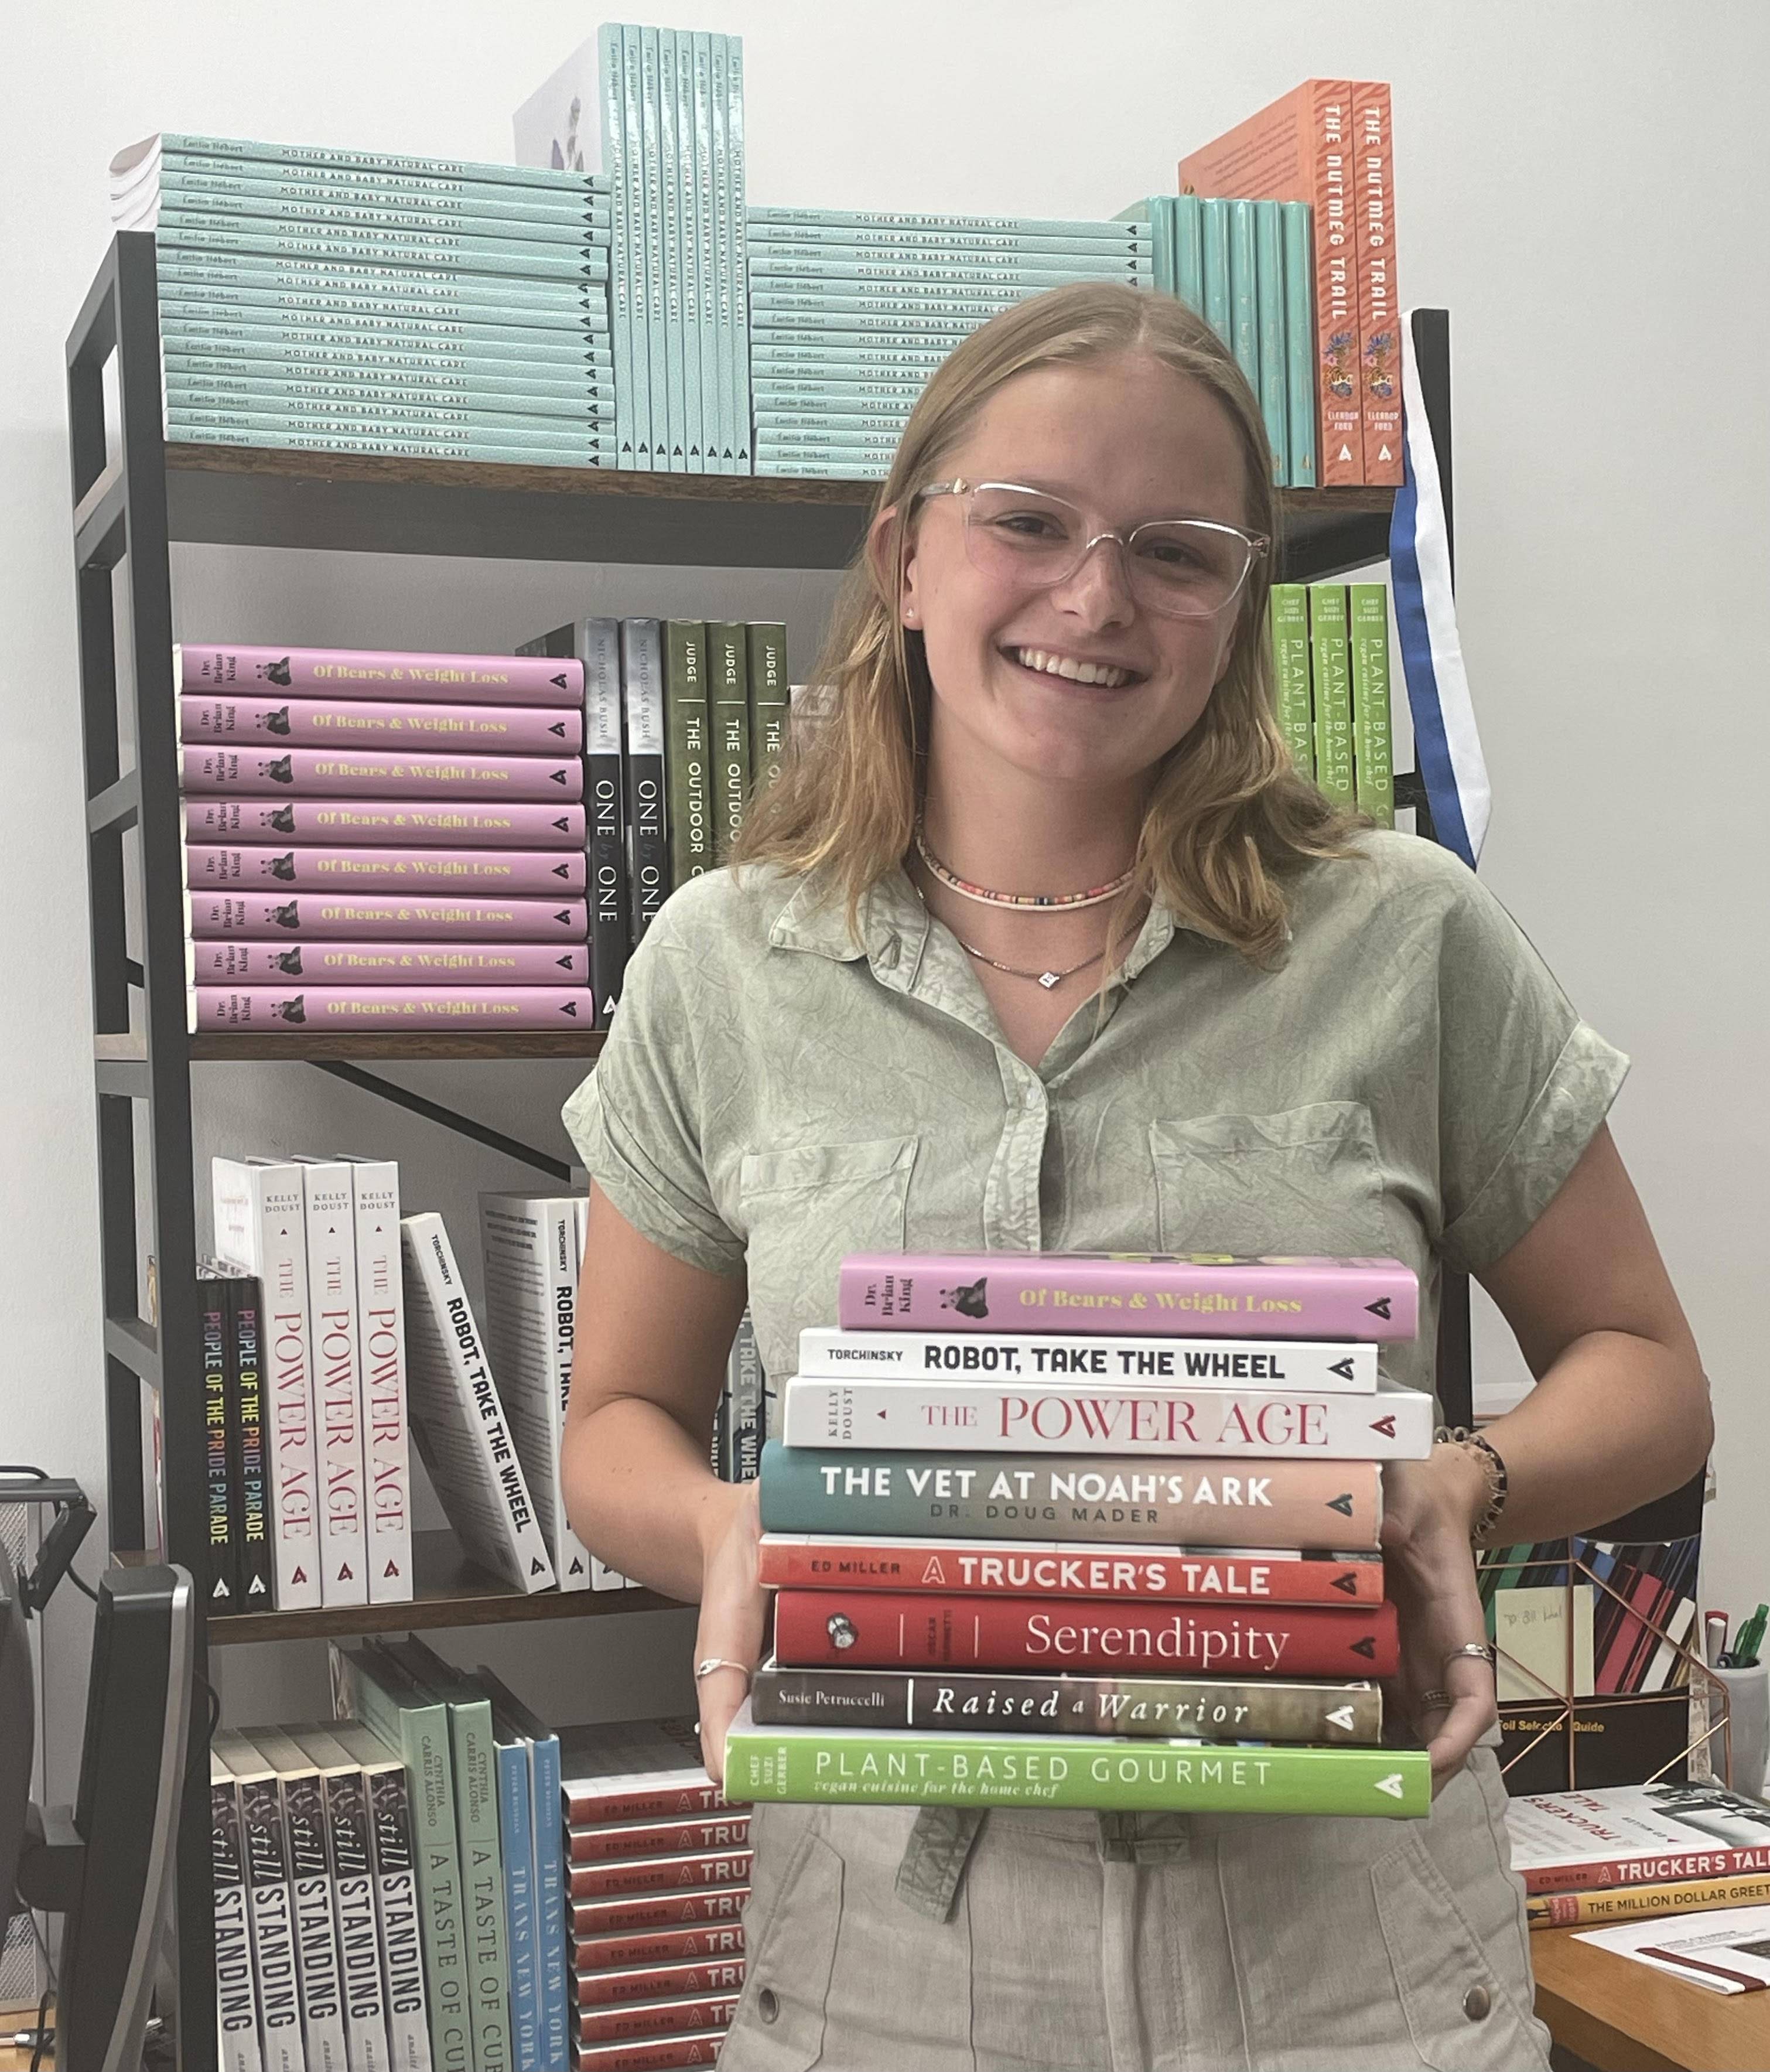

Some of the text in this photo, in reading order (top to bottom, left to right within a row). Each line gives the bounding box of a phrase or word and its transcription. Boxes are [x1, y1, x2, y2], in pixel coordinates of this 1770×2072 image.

[329, 210, 351, 218] AND
[1324, 104, 1348, 319] THE NUTMEG TRAIL
[1364, 107, 1388, 319] THE NUTMEG TRAIL
[214, 654, 223, 684] Brian
[227, 656, 237, 681] King
[313, 664, 509, 684] Of Bears & Weight Loss
[686, 641, 696, 684] JUDGE
[725, 643, 736, 685] JUDGE
[597, 639, 608, 738] NICHOLAS BUSH
[686, 718, 701, 751] THE
[726, 719, 741, 752] THE
[1331, 639, 1349, 791] PLANT-BASED
[596, 780, 615, 837] ONE
[688, 762, 703, 854] OUTDOOR
[598, 865, 617, 922] ONE
[265, 1203, 300, 1214] DOUST
[266, 1194, 299, 1203] KELLY
[360, 1200, 395, 1210] DOUST
[361, 1192, 394, 1200] KELLY
[558, 1220, 568, 1271] TORCHINSKY
[865, 1284, 877, 1308] Dr.
[881, 1275, 895, 1317] Brian
[898, 1278, 913, 1314] King
[1019, 1288, 1303, 1316] Of Bears & Weight Loss
[556, 1286, 574, 1353] ROBOT,
[739, 1333, 756, 1386] TAKE
[827, 1346, 1285, 1380] TORCHINSKY ROBOT, TAKE THE WHEEL
[274, 1258, 312, 1541] THE POWER AGE
[368, 1255, 404, 1534] THE POWER AGE
[430, 1234, 532, 1534] TORCHINSKY ROBOT, TAKE THE WHEEL
[238, 1309, 264, 1542] PEOPLE OF THE PRIDE PARADE
[740, 1391, 757, 1430] THE
[828, 1388, 838, 1438] KELLY
[843, 1387, 853, 1440] DOUST
[920, 1397, 1330, 1446] THE POWER AGE
[821, 1466, 1273, 1507] THE VET AT NOAH'S ARK
[930, 1503, 1159, 1523] DR. DOUG MADER
[811, 1557, 1271, 1595] ED MILLER A TRUCKER'S TALE
[1025, 1614, 1290, 1671] Serendipity
[778, 1688, 885, 1708] Susie Petruccelli
[932, 1688, 1250, 1722] Raised a Warrior
[1573, 1722, 1604, 1732] Guide
[466, 1733, 480, 1822] CARRIS ALONSO
[478, 1752, 488, 1803] CYNTHIA
[750, 1755, 760, 1786] CHEF
[763, 1757, 774, 1784] SUZI
[777, 1746, 787, 1795] GERBER
[814, 1780, 1060, 1798] vegan cuisine for the home chef
[815, 1752, 1272, 1787] PLANT-BASED GOURMET
[293, 1816, 324, 1873] still
[377, 1811, 408, 1868] still
[472, 1849, 491, 1866] A
[1554, 1873, 1587, 1883] MILLER
[1598, 1866, 1611, 1883] A
[1617, 1854, 1726, 1881] TRUCKER'S
[474, 1876, 498, 1965] TASTE
[1588, 1901, 1613, 1914] THE
[1617, 1895, 1670, 1911] MILLION
[1674, 1888, 1726, 1904] DOLLAR
[298, 1879, 337, 2020] STANDING
[382, 1875, 422, 2015] STANDING
[544, 1860, 564, 2064] TRANS NEW YORK
[479, 1976, 500, 2011] OF
